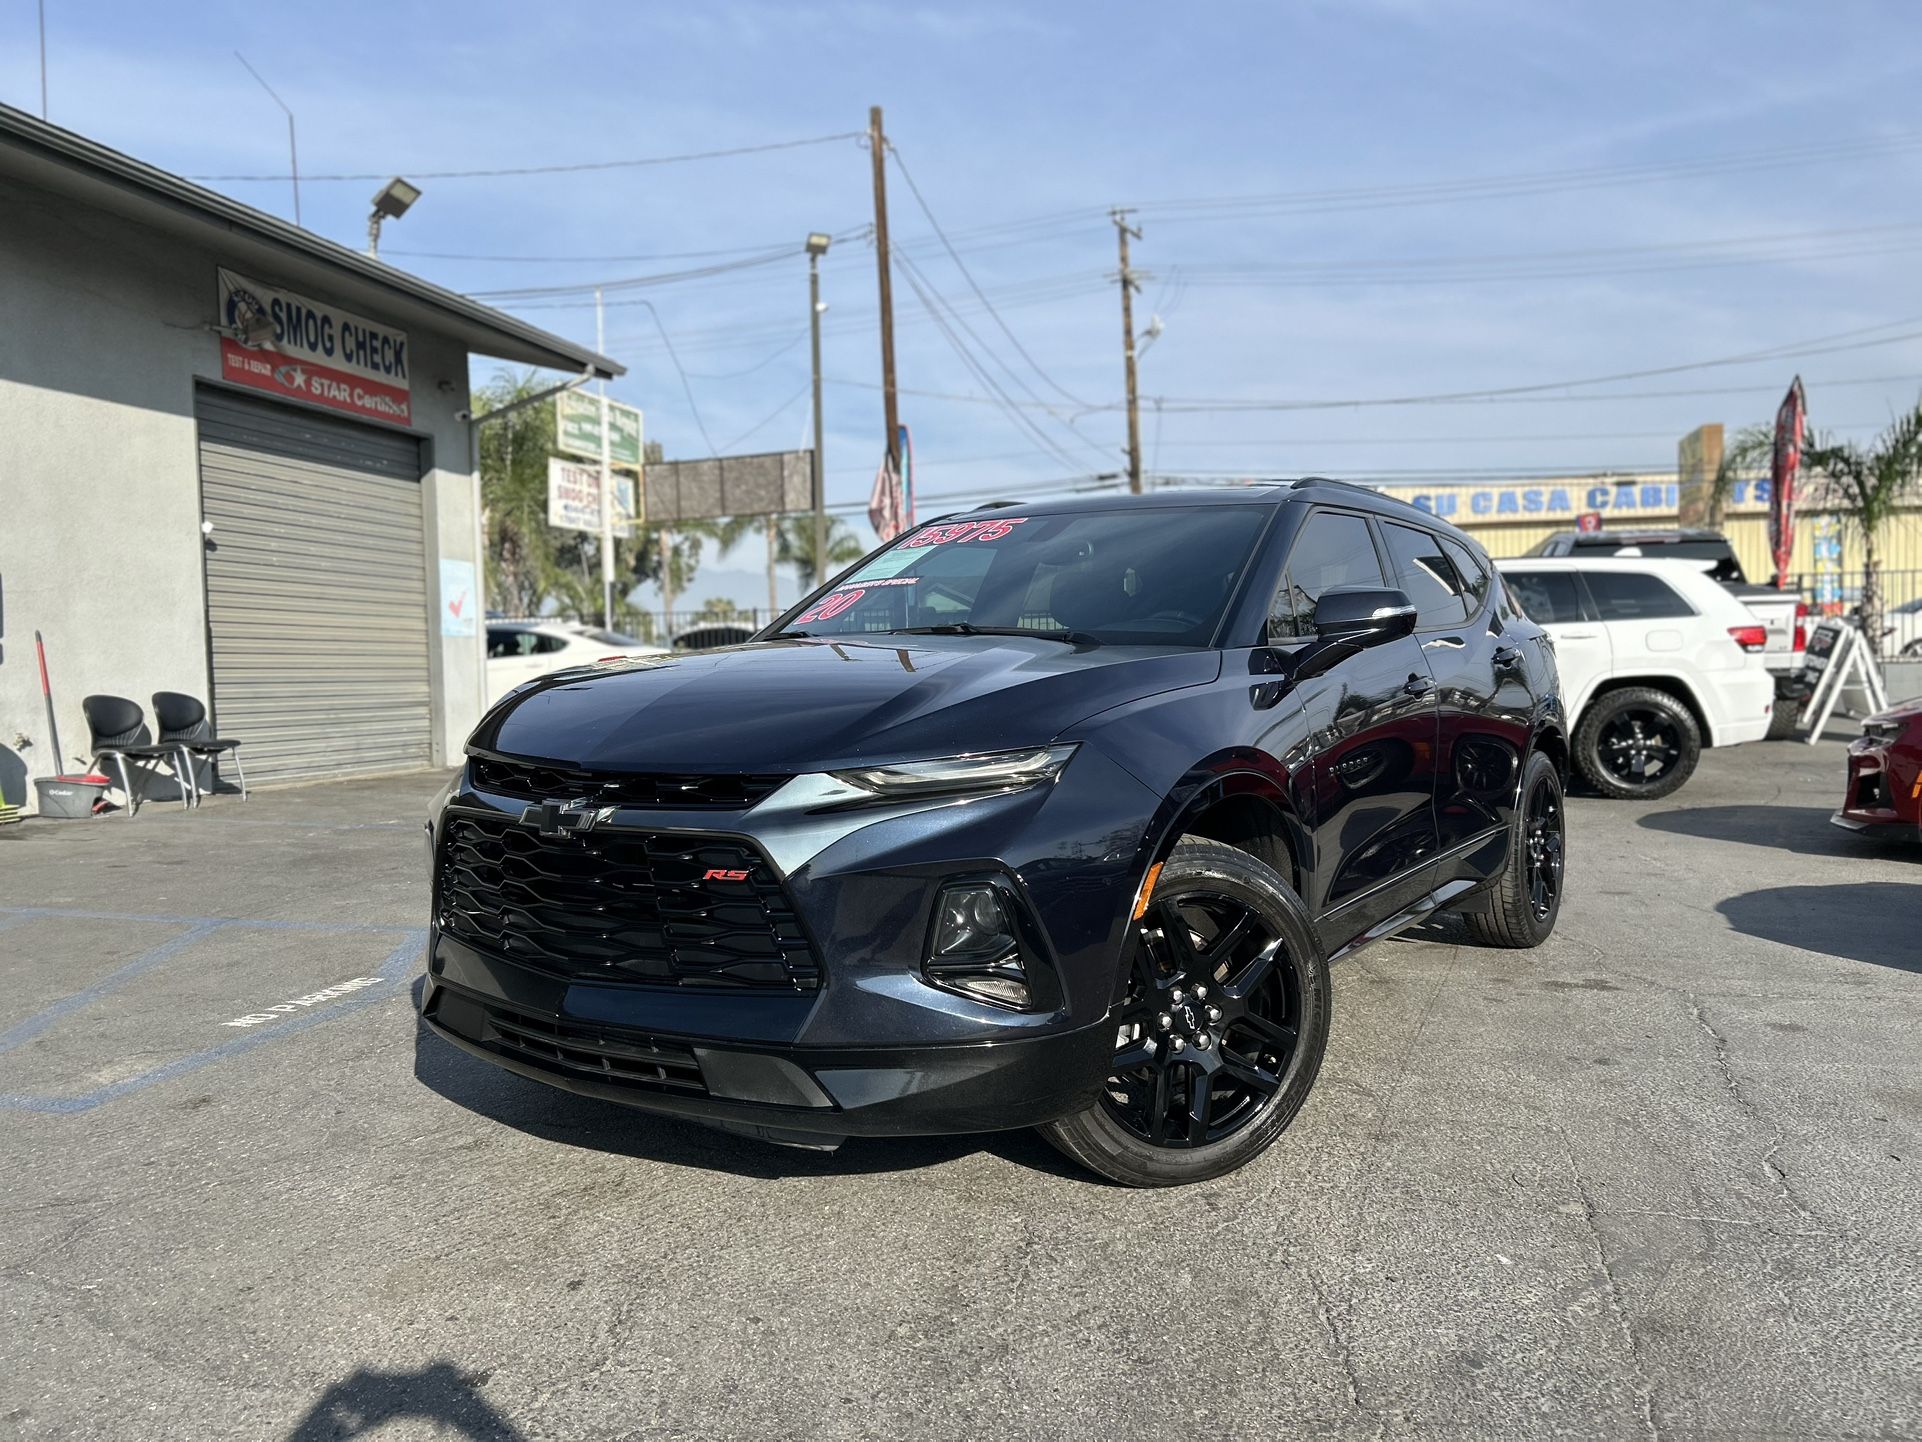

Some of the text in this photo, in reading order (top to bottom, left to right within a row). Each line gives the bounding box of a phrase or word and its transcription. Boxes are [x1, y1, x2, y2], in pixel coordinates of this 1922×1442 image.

[271, 298, 406, 380] SMOG CHECK
[227, 353, 243, 369] TEST
[250, 359, 272, 377] REPAIR
[311, 378, 351, 403] STAR
[561, 467, 584, 486] TEST
[558, 484, 583, 503] SMOG
[1412, 493, 1457, 516] SU
[1471, 489, 1571, 514] CASA
[896, 517, 1029, 550] 15975
[793, 589, 866, 626] 20
[702, 869, 749, 881] RS
[221, 977, 385, 1028] NO PARKING
